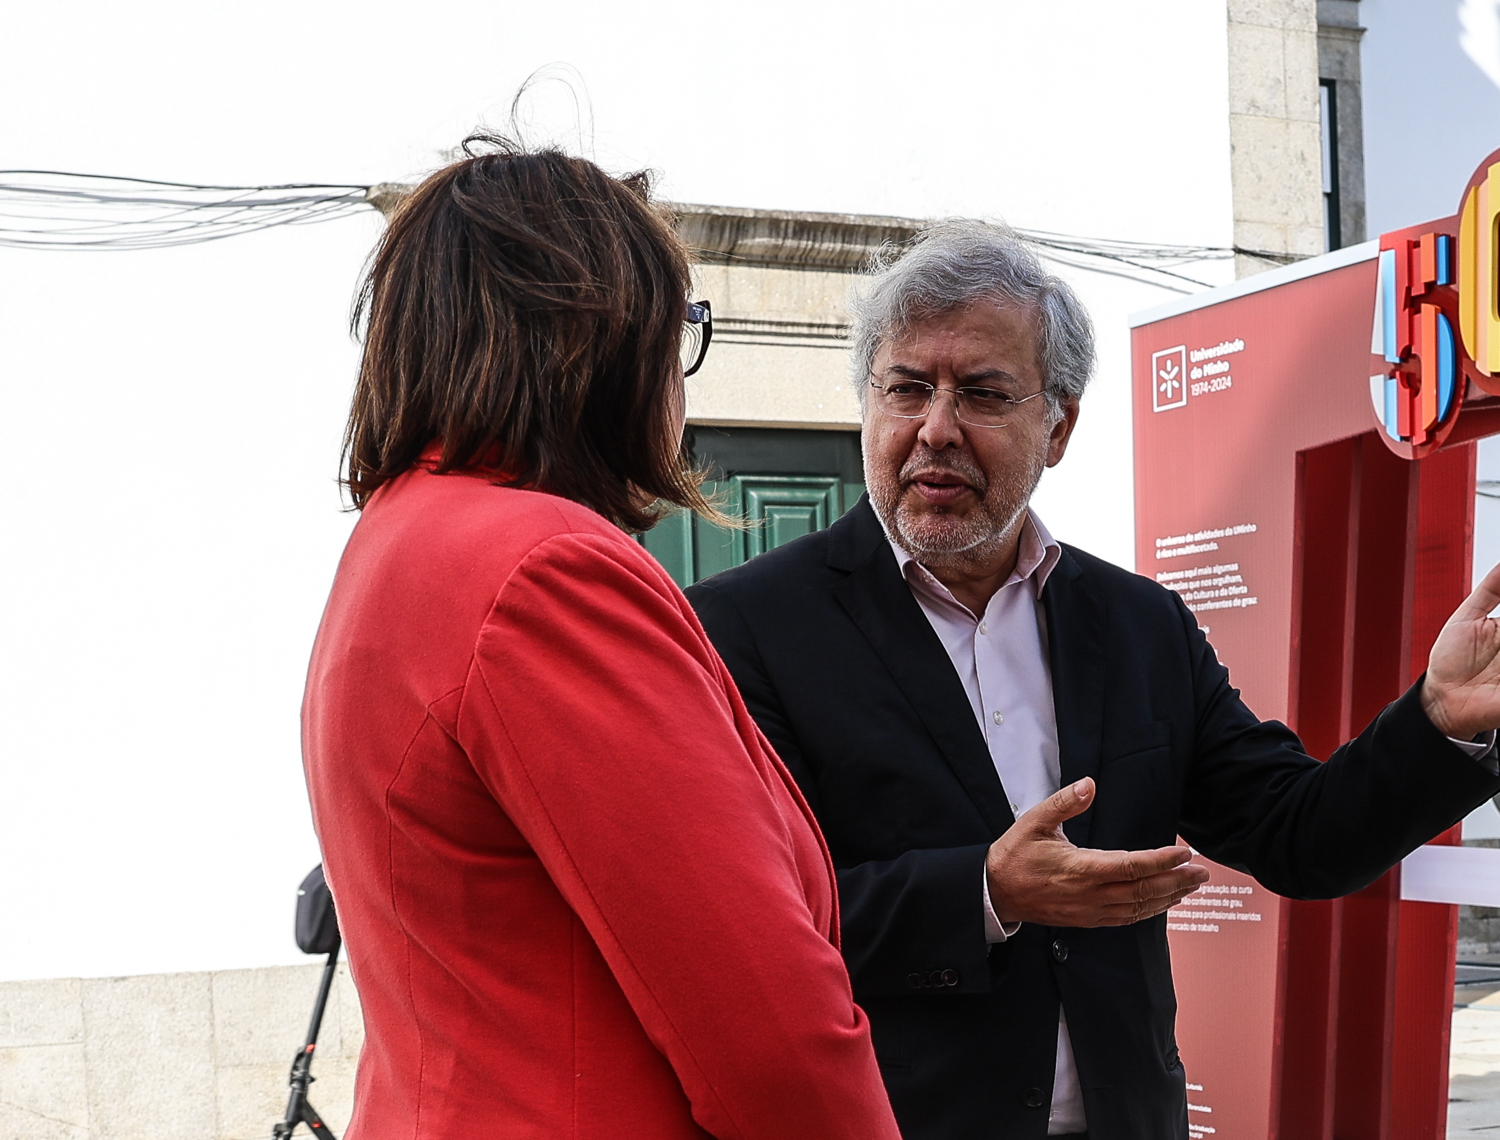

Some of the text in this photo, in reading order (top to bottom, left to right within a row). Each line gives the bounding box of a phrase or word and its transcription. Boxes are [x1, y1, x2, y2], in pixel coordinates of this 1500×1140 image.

[1190, 338, 1245, 363] Universidade
[1190, 360, 1230, 379] do Minho
[1190, 375, 1232, 396] 1974-2024
